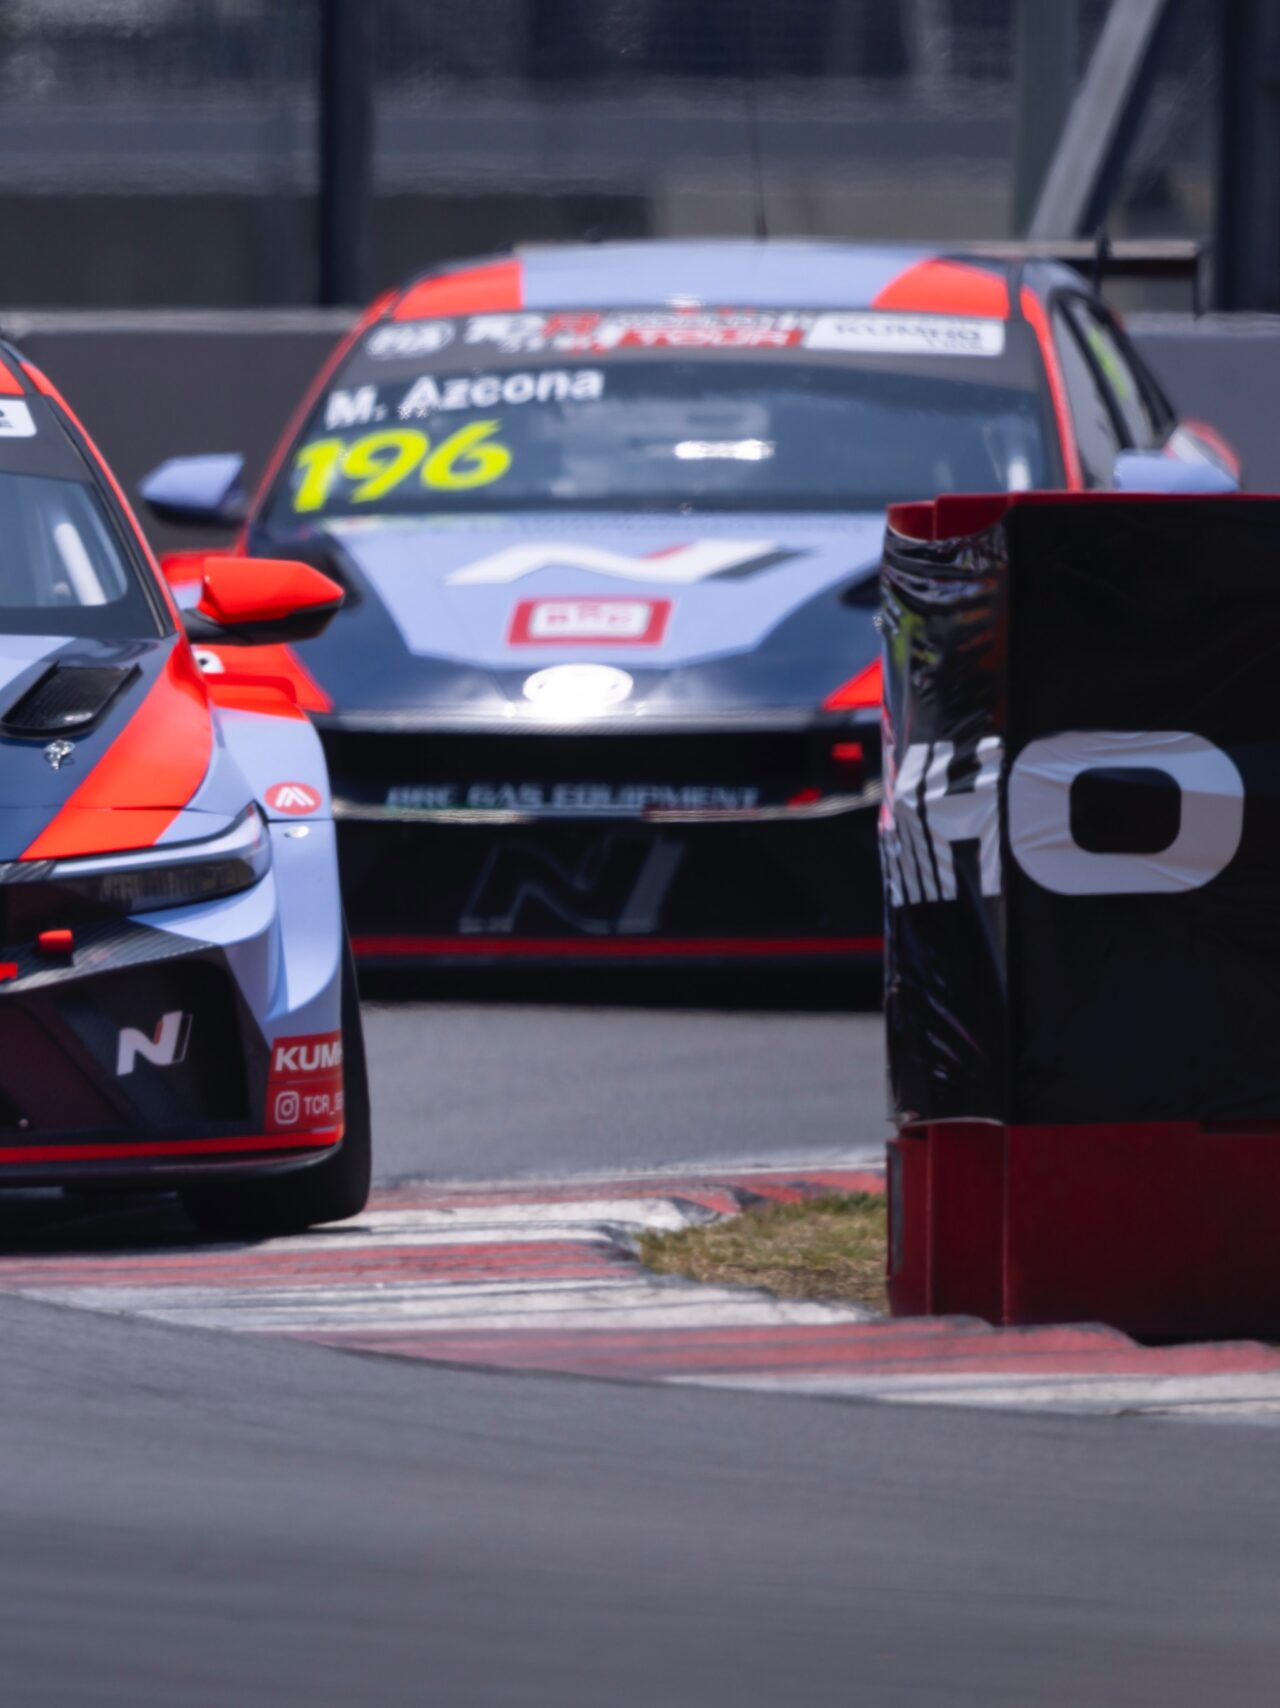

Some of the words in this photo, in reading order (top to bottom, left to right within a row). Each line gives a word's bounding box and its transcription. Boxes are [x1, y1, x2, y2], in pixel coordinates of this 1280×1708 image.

[324, 384, 388, 431] M.
[397, 369, 605, 420] Azcona
[292, 418, 513, 514] 196
[468, 783, 544, 808] GAS
[274, 1041, 342, 1072] KUM
